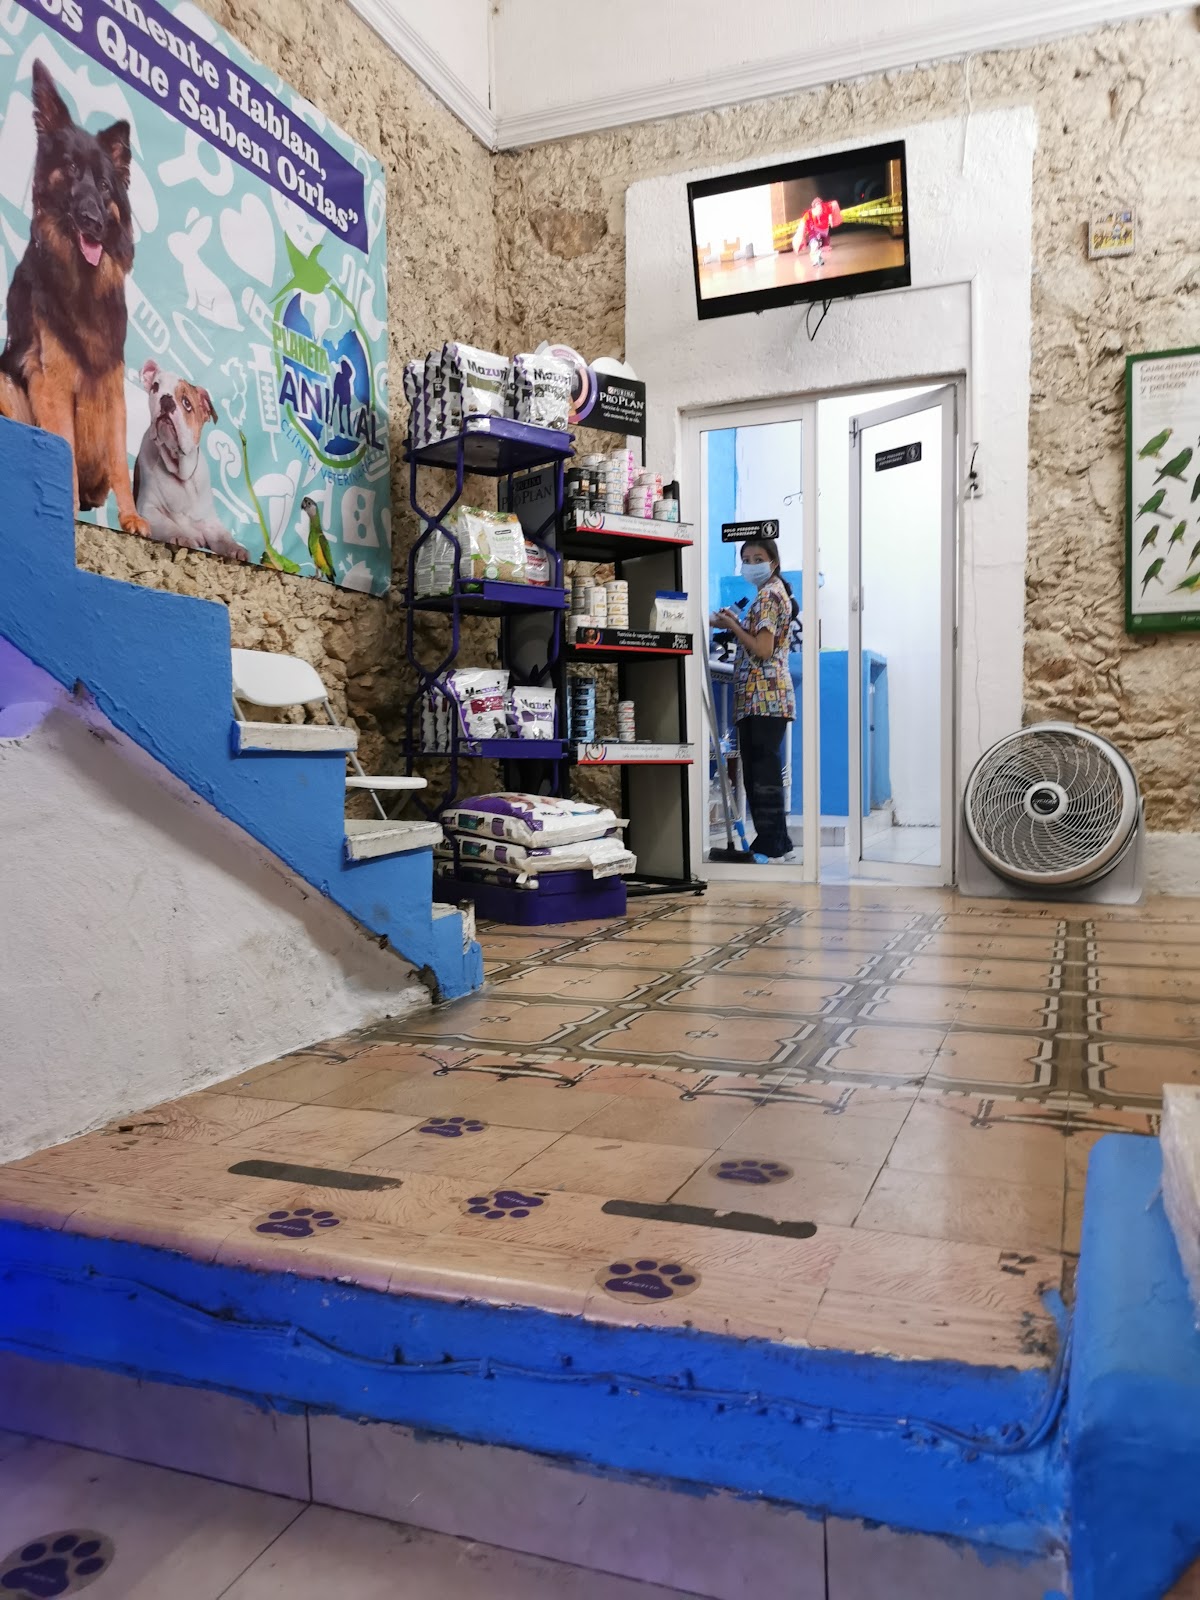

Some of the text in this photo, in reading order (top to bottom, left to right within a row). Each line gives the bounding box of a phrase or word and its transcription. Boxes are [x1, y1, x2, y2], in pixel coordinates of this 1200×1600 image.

[97, 16, 169, 98] Que
[179, 79, 270, 174] Saben
[226, 69, 327, 181] Hablan,
[273, 322, 330, 376] PLANETA
[467, 359, 508, 381] Mazuri
[533, 368, 572, 386] Mazuri
[599, 391, 645, 410] PRO PLAN
[519, 698, 552, 710] Mazuri
